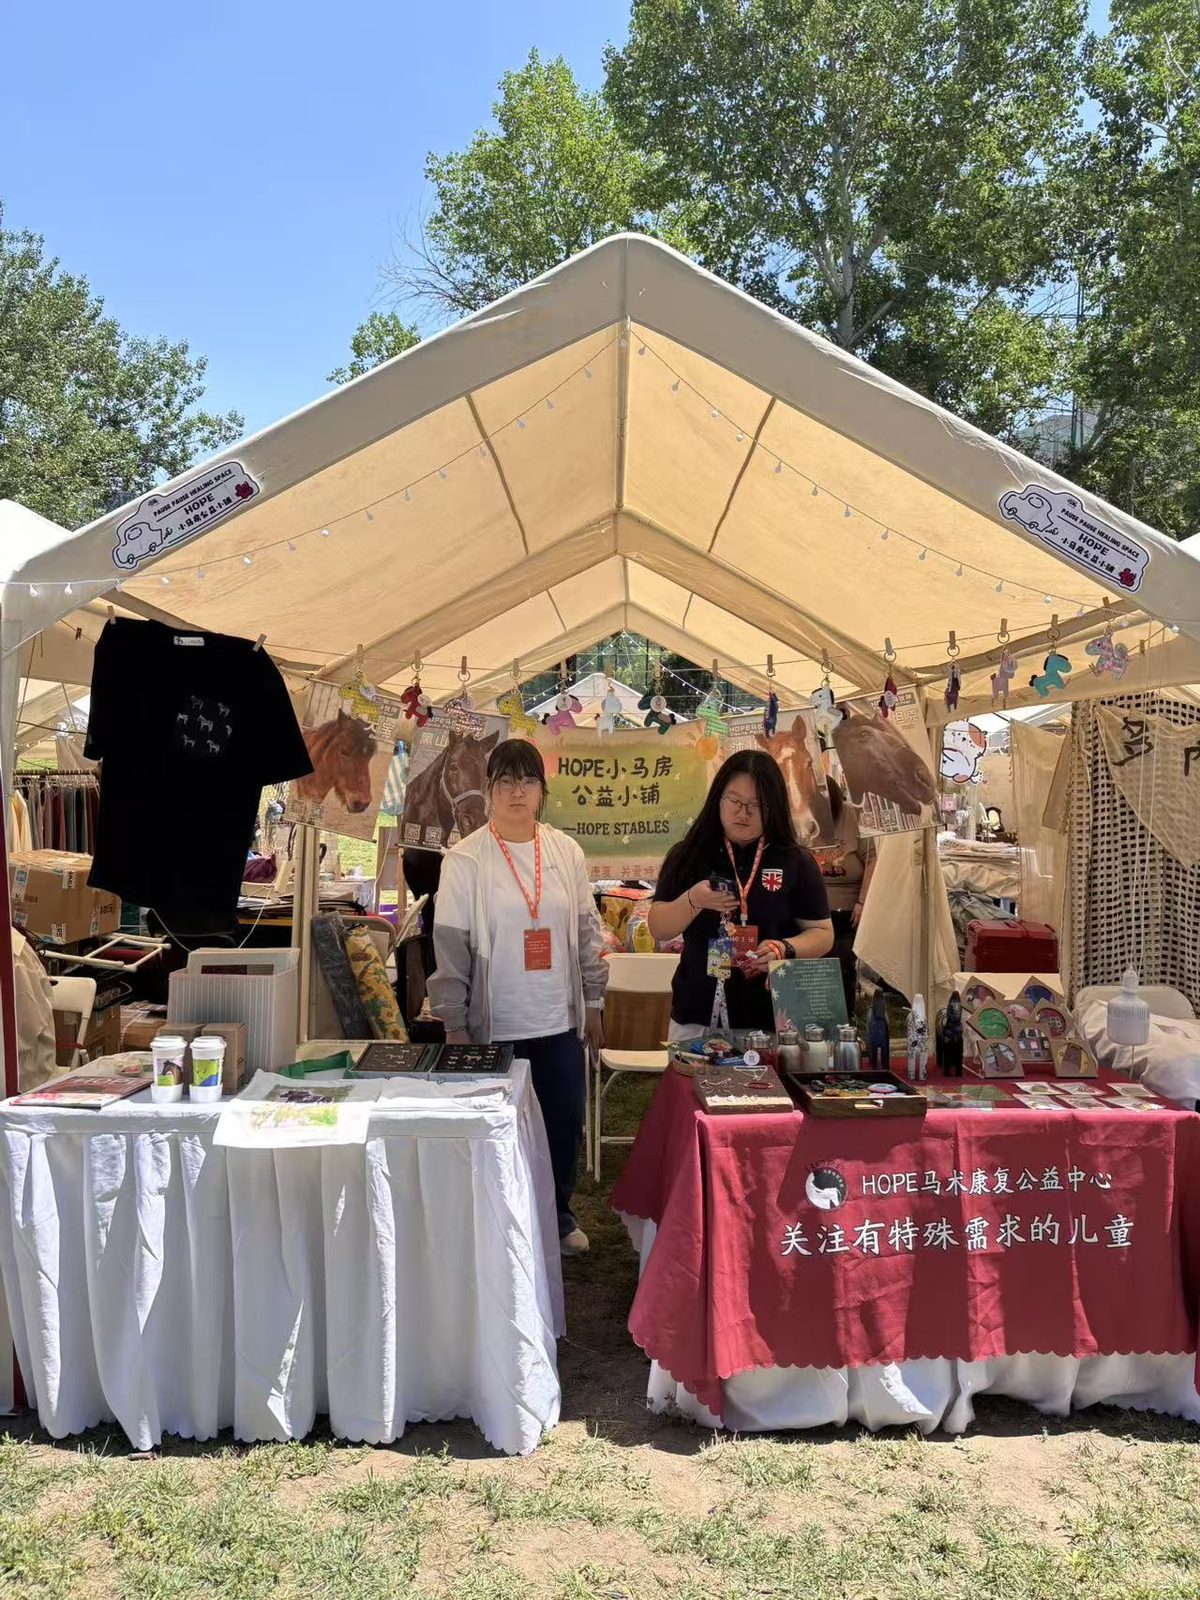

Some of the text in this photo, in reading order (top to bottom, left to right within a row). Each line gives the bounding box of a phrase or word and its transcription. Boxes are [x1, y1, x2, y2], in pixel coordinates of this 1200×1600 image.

[153, 503, 171, 517] PAUSE
[171, 494, 189, 508] PAUSE
[189, 479, 214, 497] HEALING
[214, 468, 232, 483] SPACE
[184, 493, 215, 515] HOPE
[1061, 508, 1140, 559] PAUSE PAUSE HEALING SPACE
[1079, 533, 1109, 556] HOPE
[558, 756, 673, 780] HOPE小马房
[572, 782, 660, 807] 公益小铺
[613, 820, 670, 836] STABLES
[861, 1165, 1112, 1198] HOPE马术康复公益中心
[780, 1213, 1136, 1257] 关注有特殊需求的儿童
